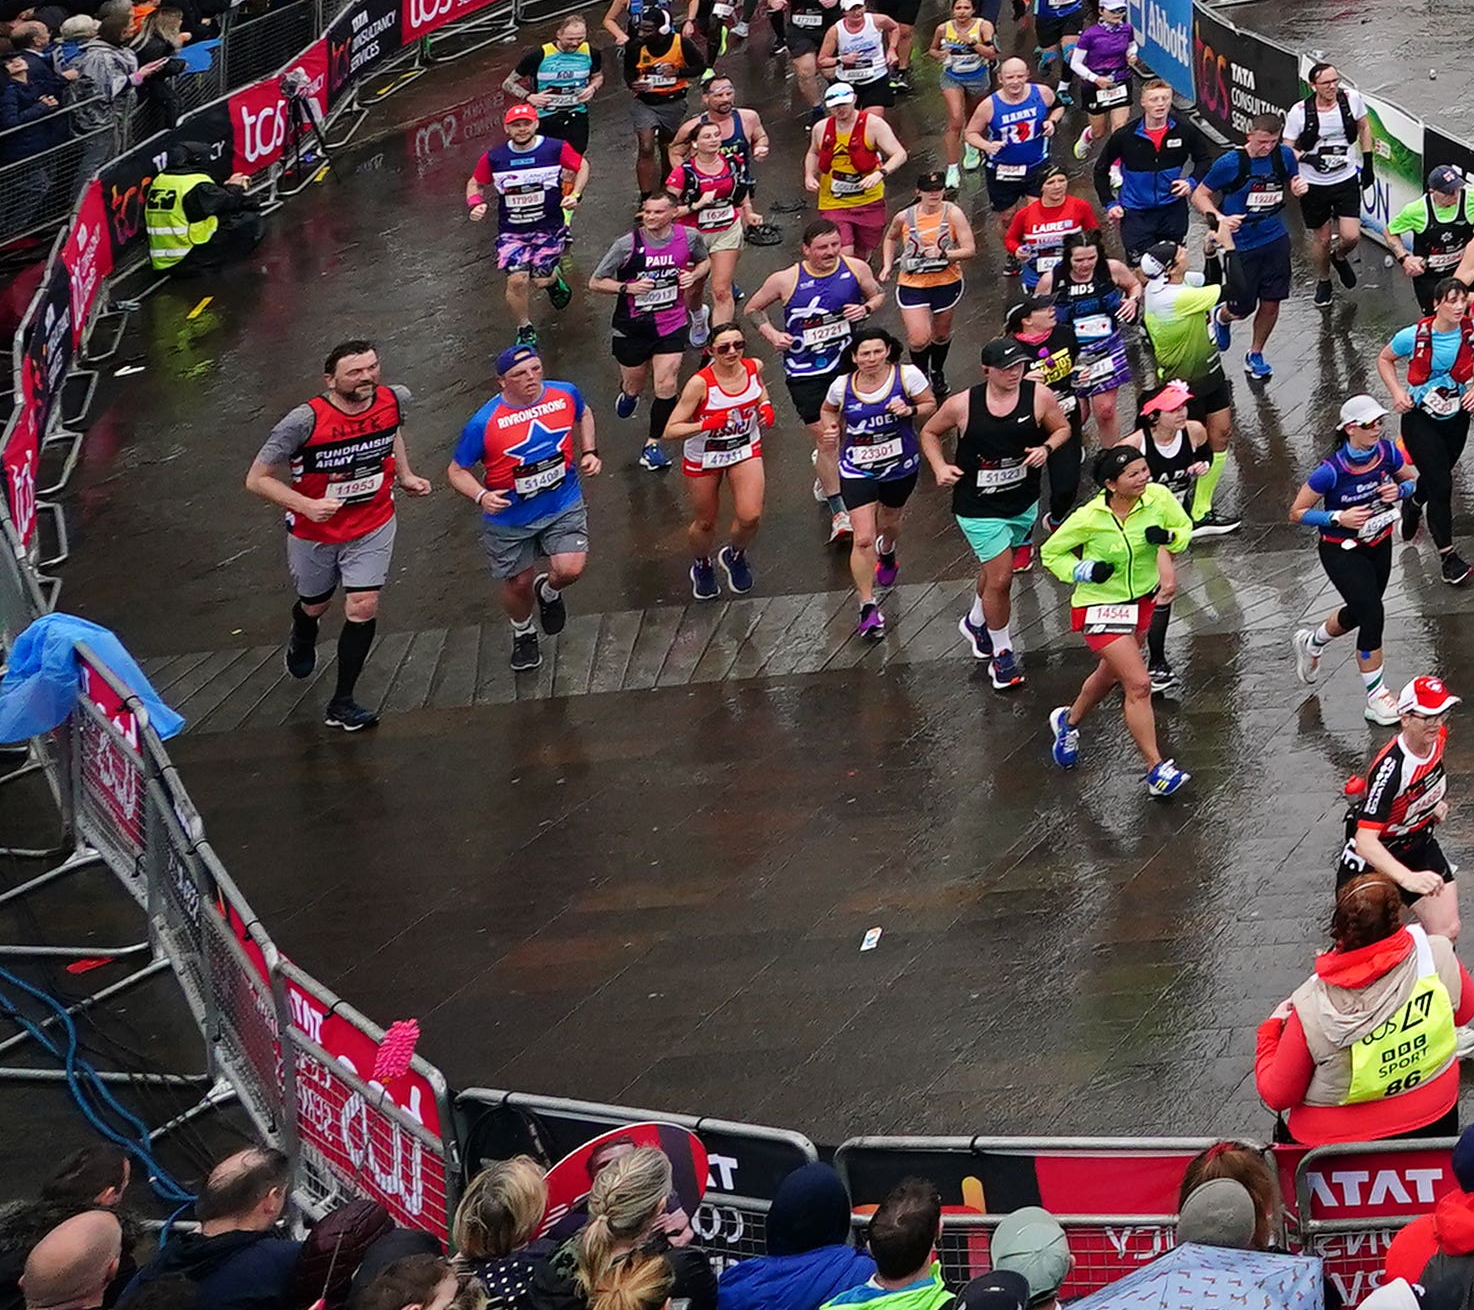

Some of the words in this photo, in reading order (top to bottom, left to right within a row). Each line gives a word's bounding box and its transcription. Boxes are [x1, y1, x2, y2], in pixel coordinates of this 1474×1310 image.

[1147, 4, 1190, 67] Abbott
[1231, 63, 1255, 90] TATA
[240, 97, 286, 164] tcs
[646, 255, 674, 267] PAUL
[810, 323, 848, 342] 12721
[316, 454, 354, 468] ARMY
[860, 443, 895, 461] 23301
[985, 469, 1022, 483] 51323
[335, 480, 375, 495] 11953
[1097, 607, 1131, 620] 14544
[1381, 1033, 1427, 1063] BBC
[1378, 1045, 1430, 1078] SPORT
[1384, 1070, 1421, 1098] 86
